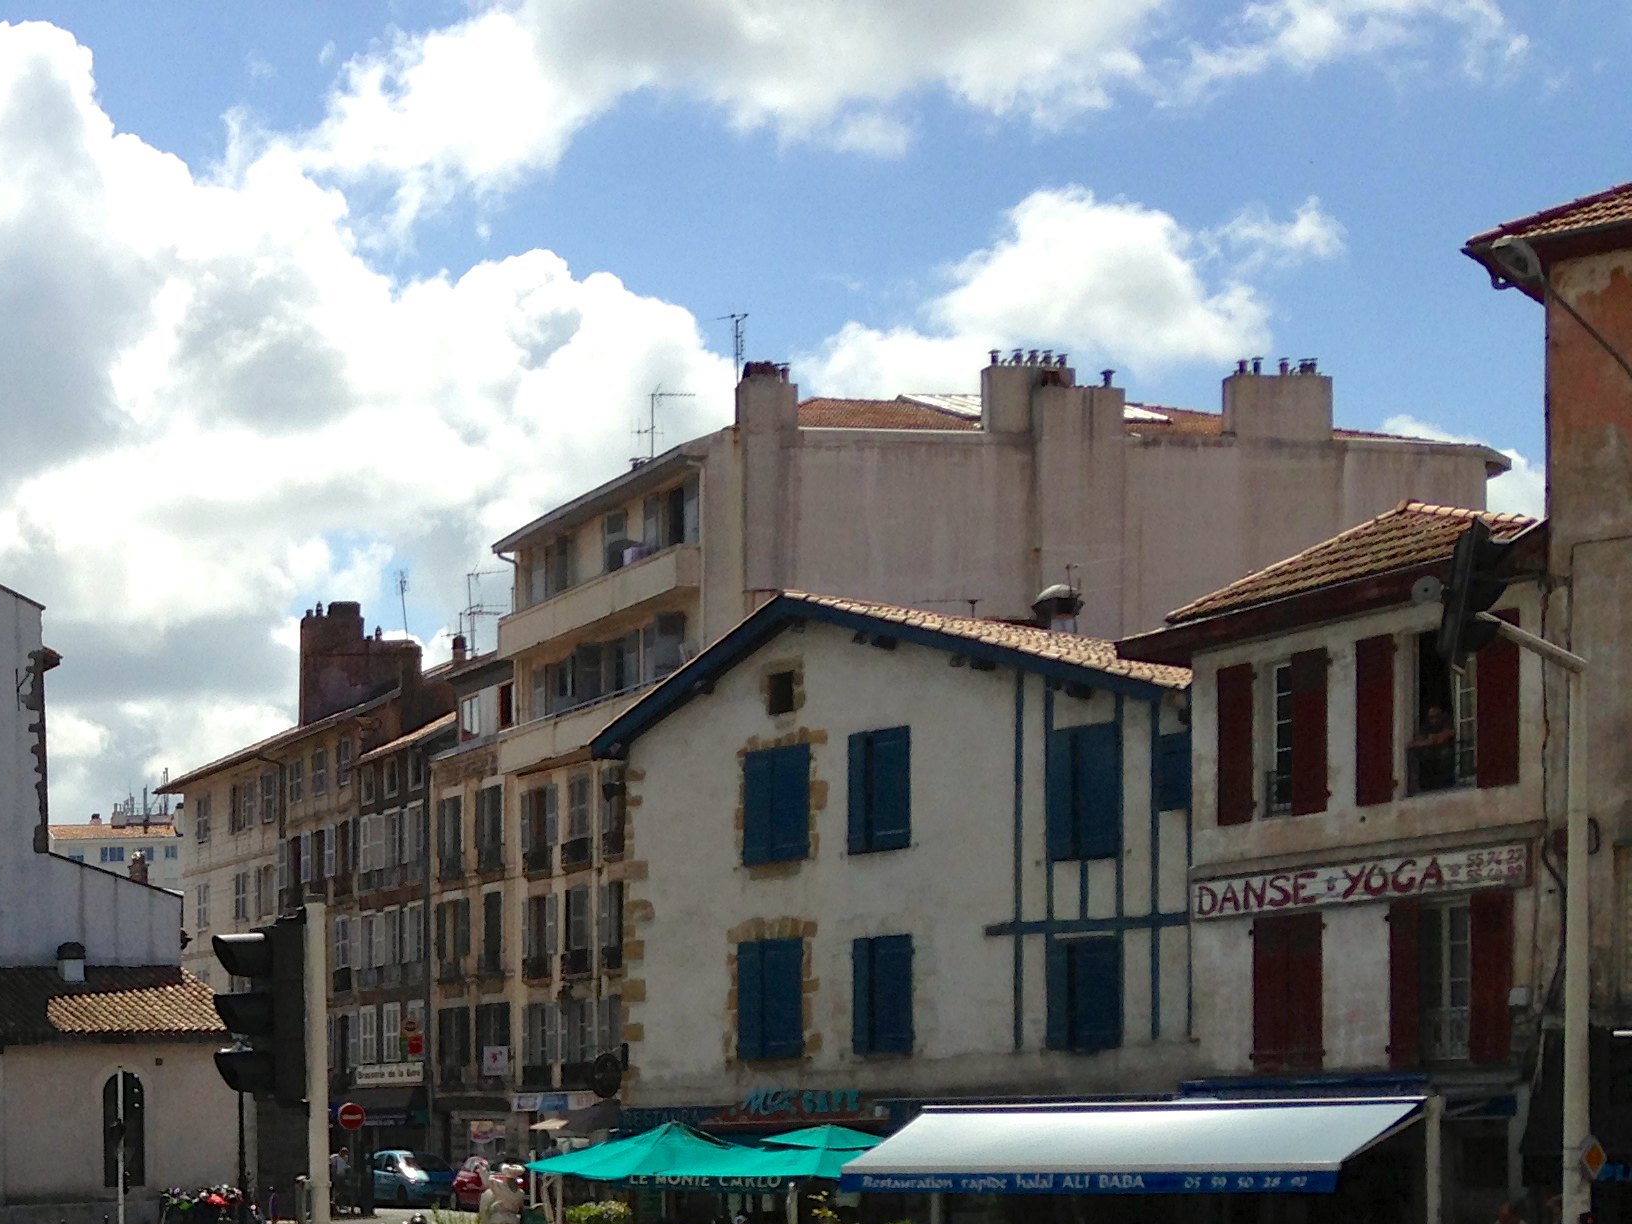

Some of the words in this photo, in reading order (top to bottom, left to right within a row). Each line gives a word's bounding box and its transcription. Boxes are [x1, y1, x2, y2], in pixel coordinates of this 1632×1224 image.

[1198, 872, 1317, 916] DANSE
[1342, 856, 1444, 899] YOGA
[629, 1175, 649, 1186] LE
[718, 1175, 782, 1188] CARLO
[863, 1175, 953, 1189] Restauration
[960, 1176, 1008, 1192] rapide
[1016, 1173, 1054, 1188] halal
[1062, 1174, 1090, 1188] ALI
[1099, 1174, 1145, 1189] BABA
[1184, 1176, 1202, 1189] 05
